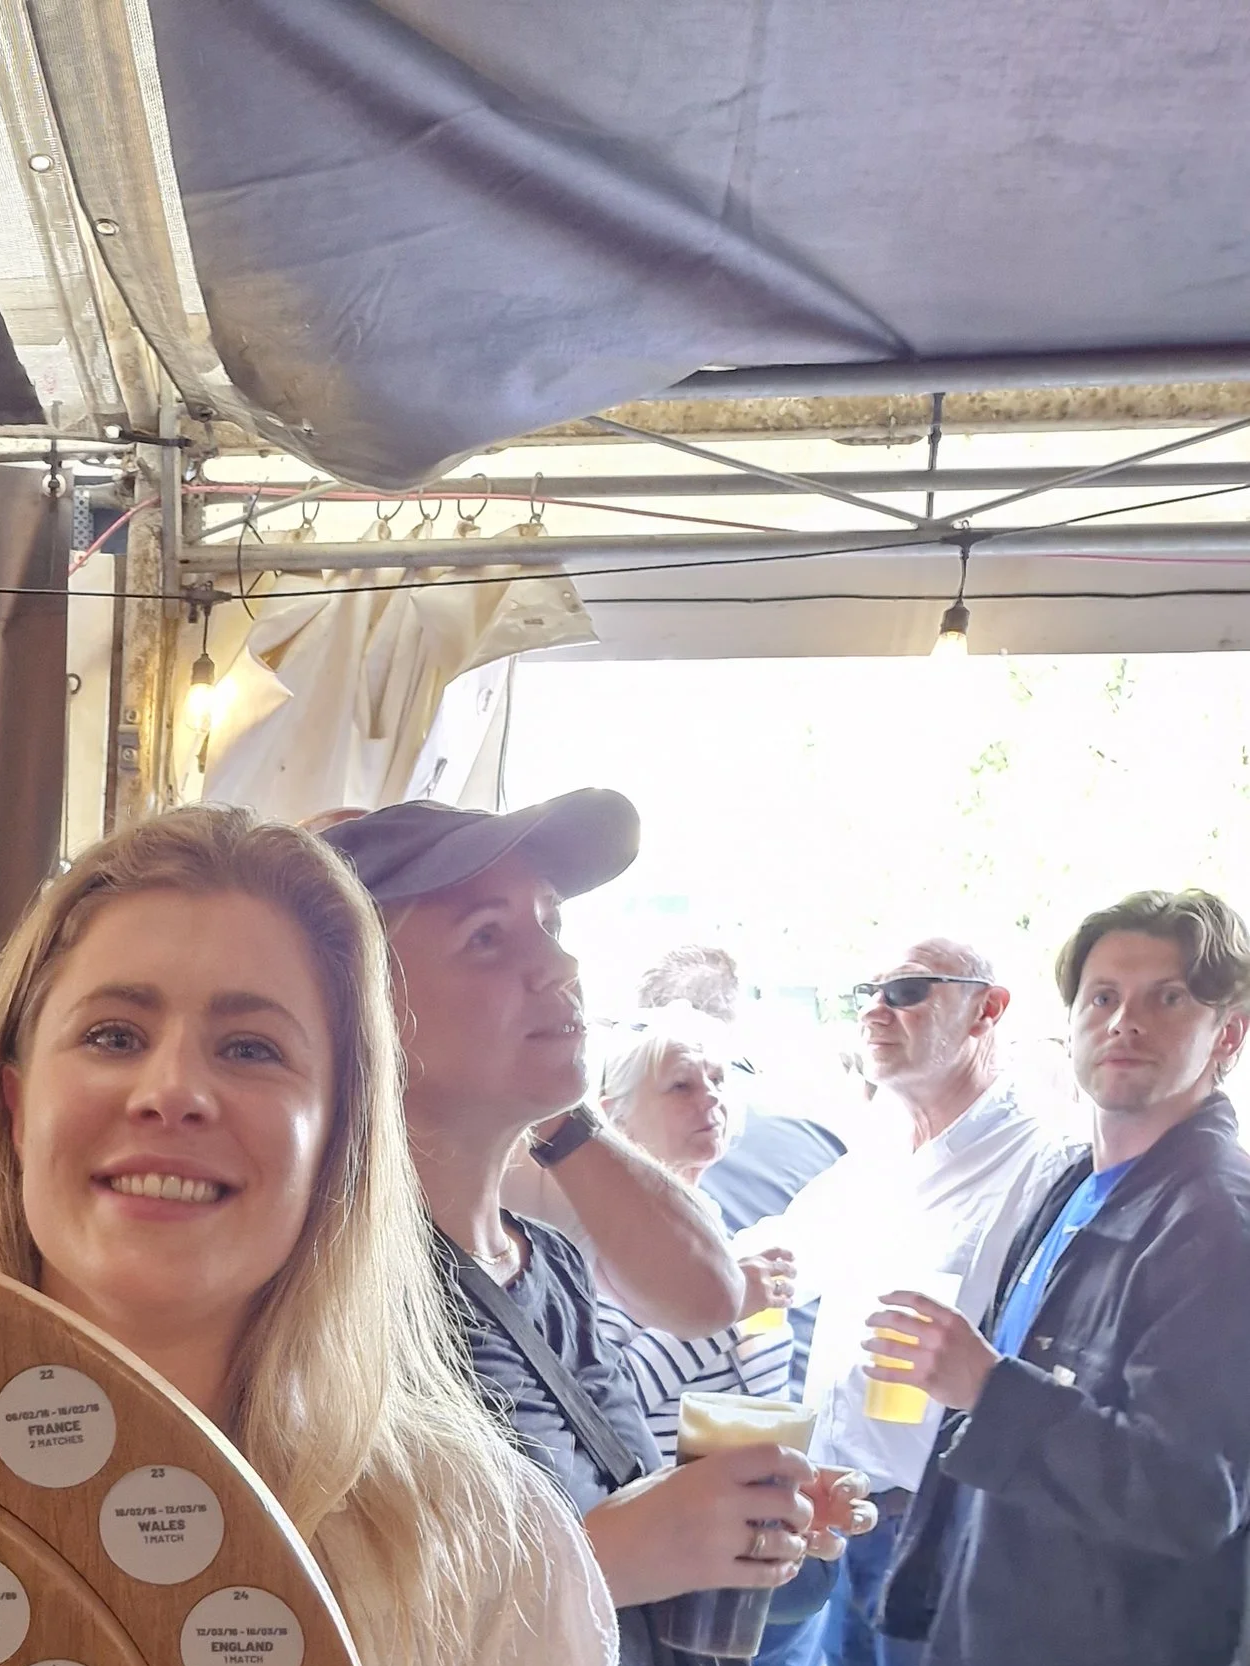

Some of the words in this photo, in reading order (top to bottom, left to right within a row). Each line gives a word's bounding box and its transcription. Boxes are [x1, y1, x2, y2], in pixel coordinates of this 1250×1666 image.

[39, 1370, 54, 1380] 22
[28, 1421, 81, 1436] FRANCE
[38, 1435, 84, 1447] MATCHES
[151, 1469, 165, 1478] 23
[138, 1520, 185, 1532] WALES
[149, 1534, 184, 1543] MATCH
[234, 1592, 249, 1600] 24
[211, 1642, 273, 1652] ENGLAND
[228, 1656, 263, 1664] MATCH
